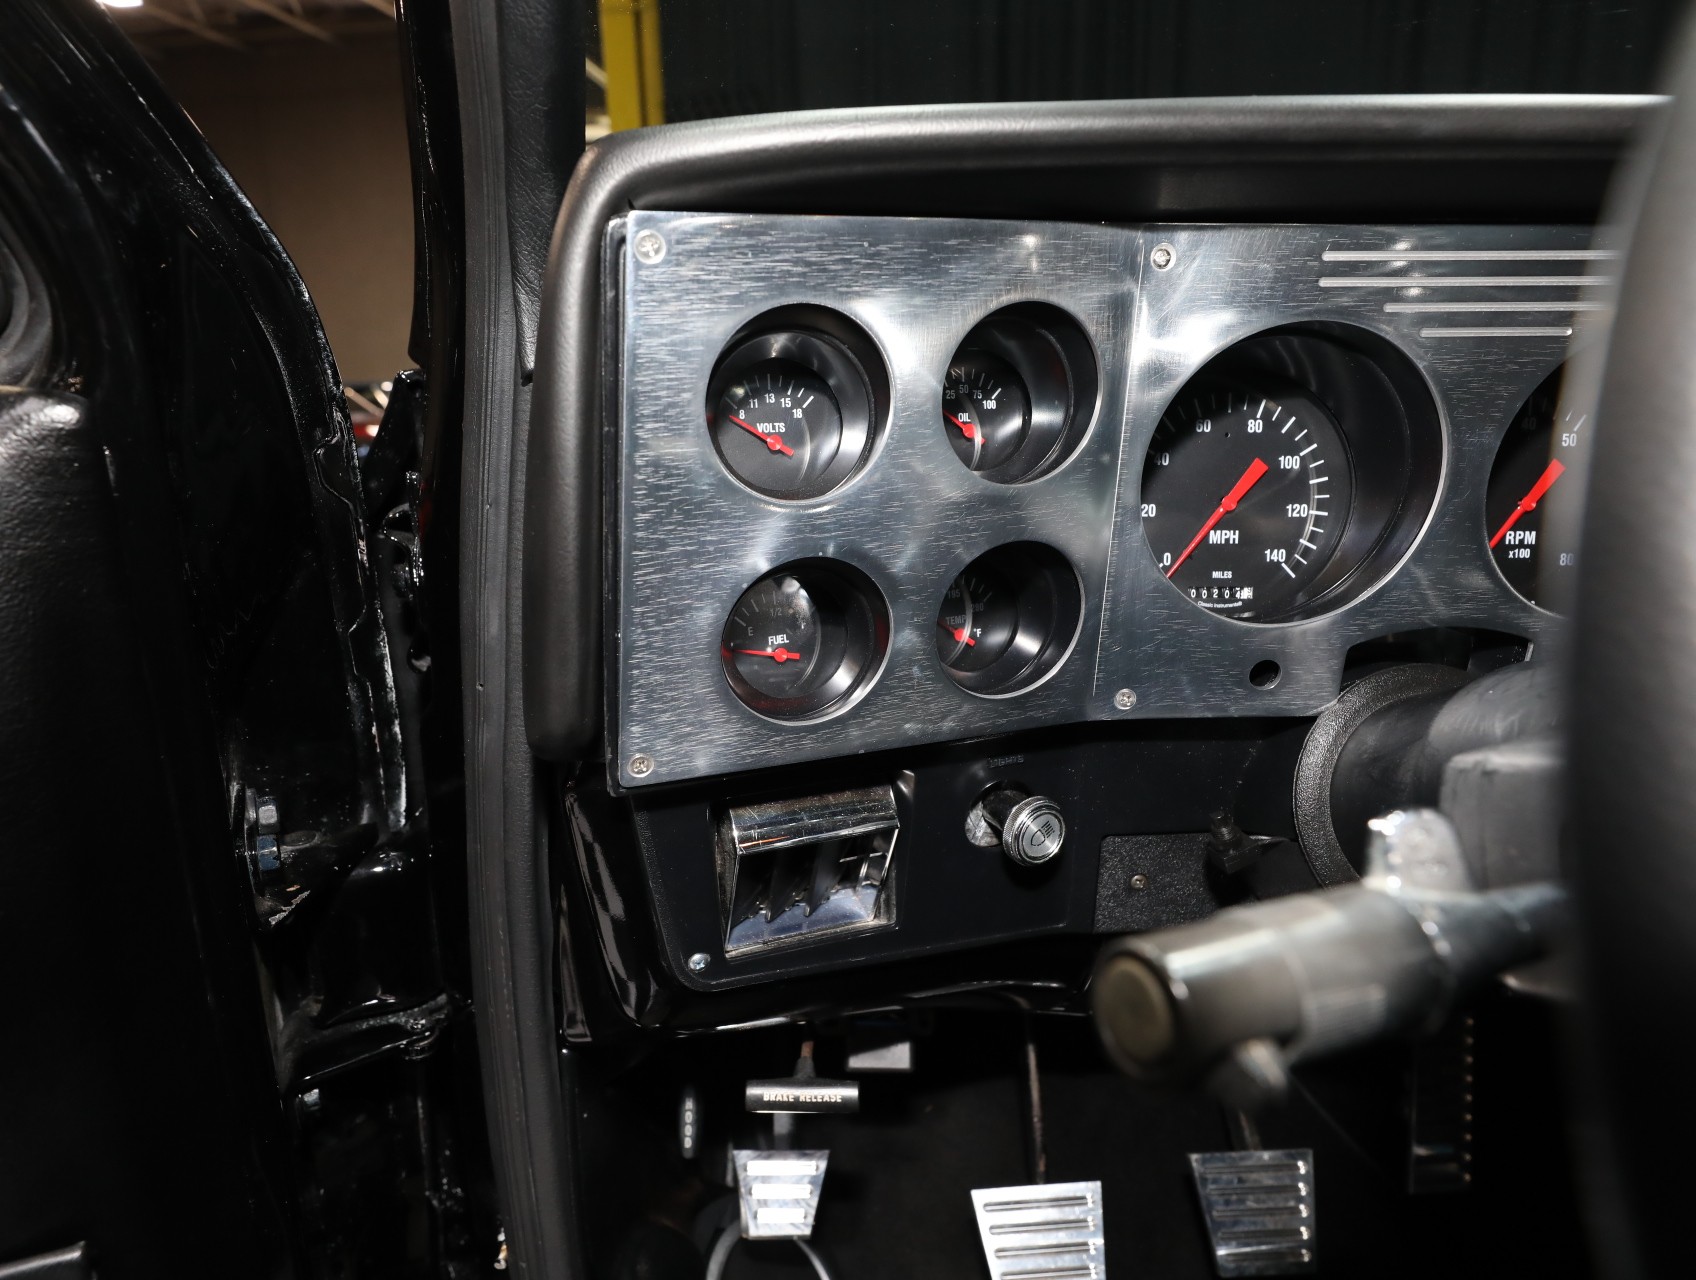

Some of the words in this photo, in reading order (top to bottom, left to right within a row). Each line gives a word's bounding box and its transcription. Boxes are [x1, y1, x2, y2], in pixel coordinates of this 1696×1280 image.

[945, 389, 956, 399] 25
[960, 384, 969, 394] 50
[973, 390, 983, 399] 75
[749, 398, 759, 408] 11
[764, 393, 776, 403] 13
[780, 397, 792, 408] 15
[982, 399, 997, 410] 100
[739, 409, 746, 419] 8
[792, 408, 803, 418] 18
[958, 412, 971, 422] OIL
[757, 423, 786, 433] VOLTS
[1196, 419, 1211, 433] 60
[1247, 419, 1263, 433] 80
[1561, 433, 1577, 447] 50
[1154, 452, 1170, 466] 40
[1278, 454, 1300, 469] 100
[1141, 503, 1156, 517] 20
[1286, 503, 1308, 517] 120
[1209, 530, 1239, 544] MPH
[1505, 531, 1536, 545] RPM
[1163, 552, 1171, 566] 0
[1265, 548, 1286, 562] 140
[1508, 548, 1531, 559] x100
[1212, 571, 1233, 579] MILES
[945, 614, 966, 625] TEMP
[747, 627, 754, 637] E
[768, 634, 790, 645] FUEL
[763, 1091, 795, 1102] BRAKE
[799, 1093, 842, 1103] RELEASE
[683, 1096, 694, 1149] HOOD
